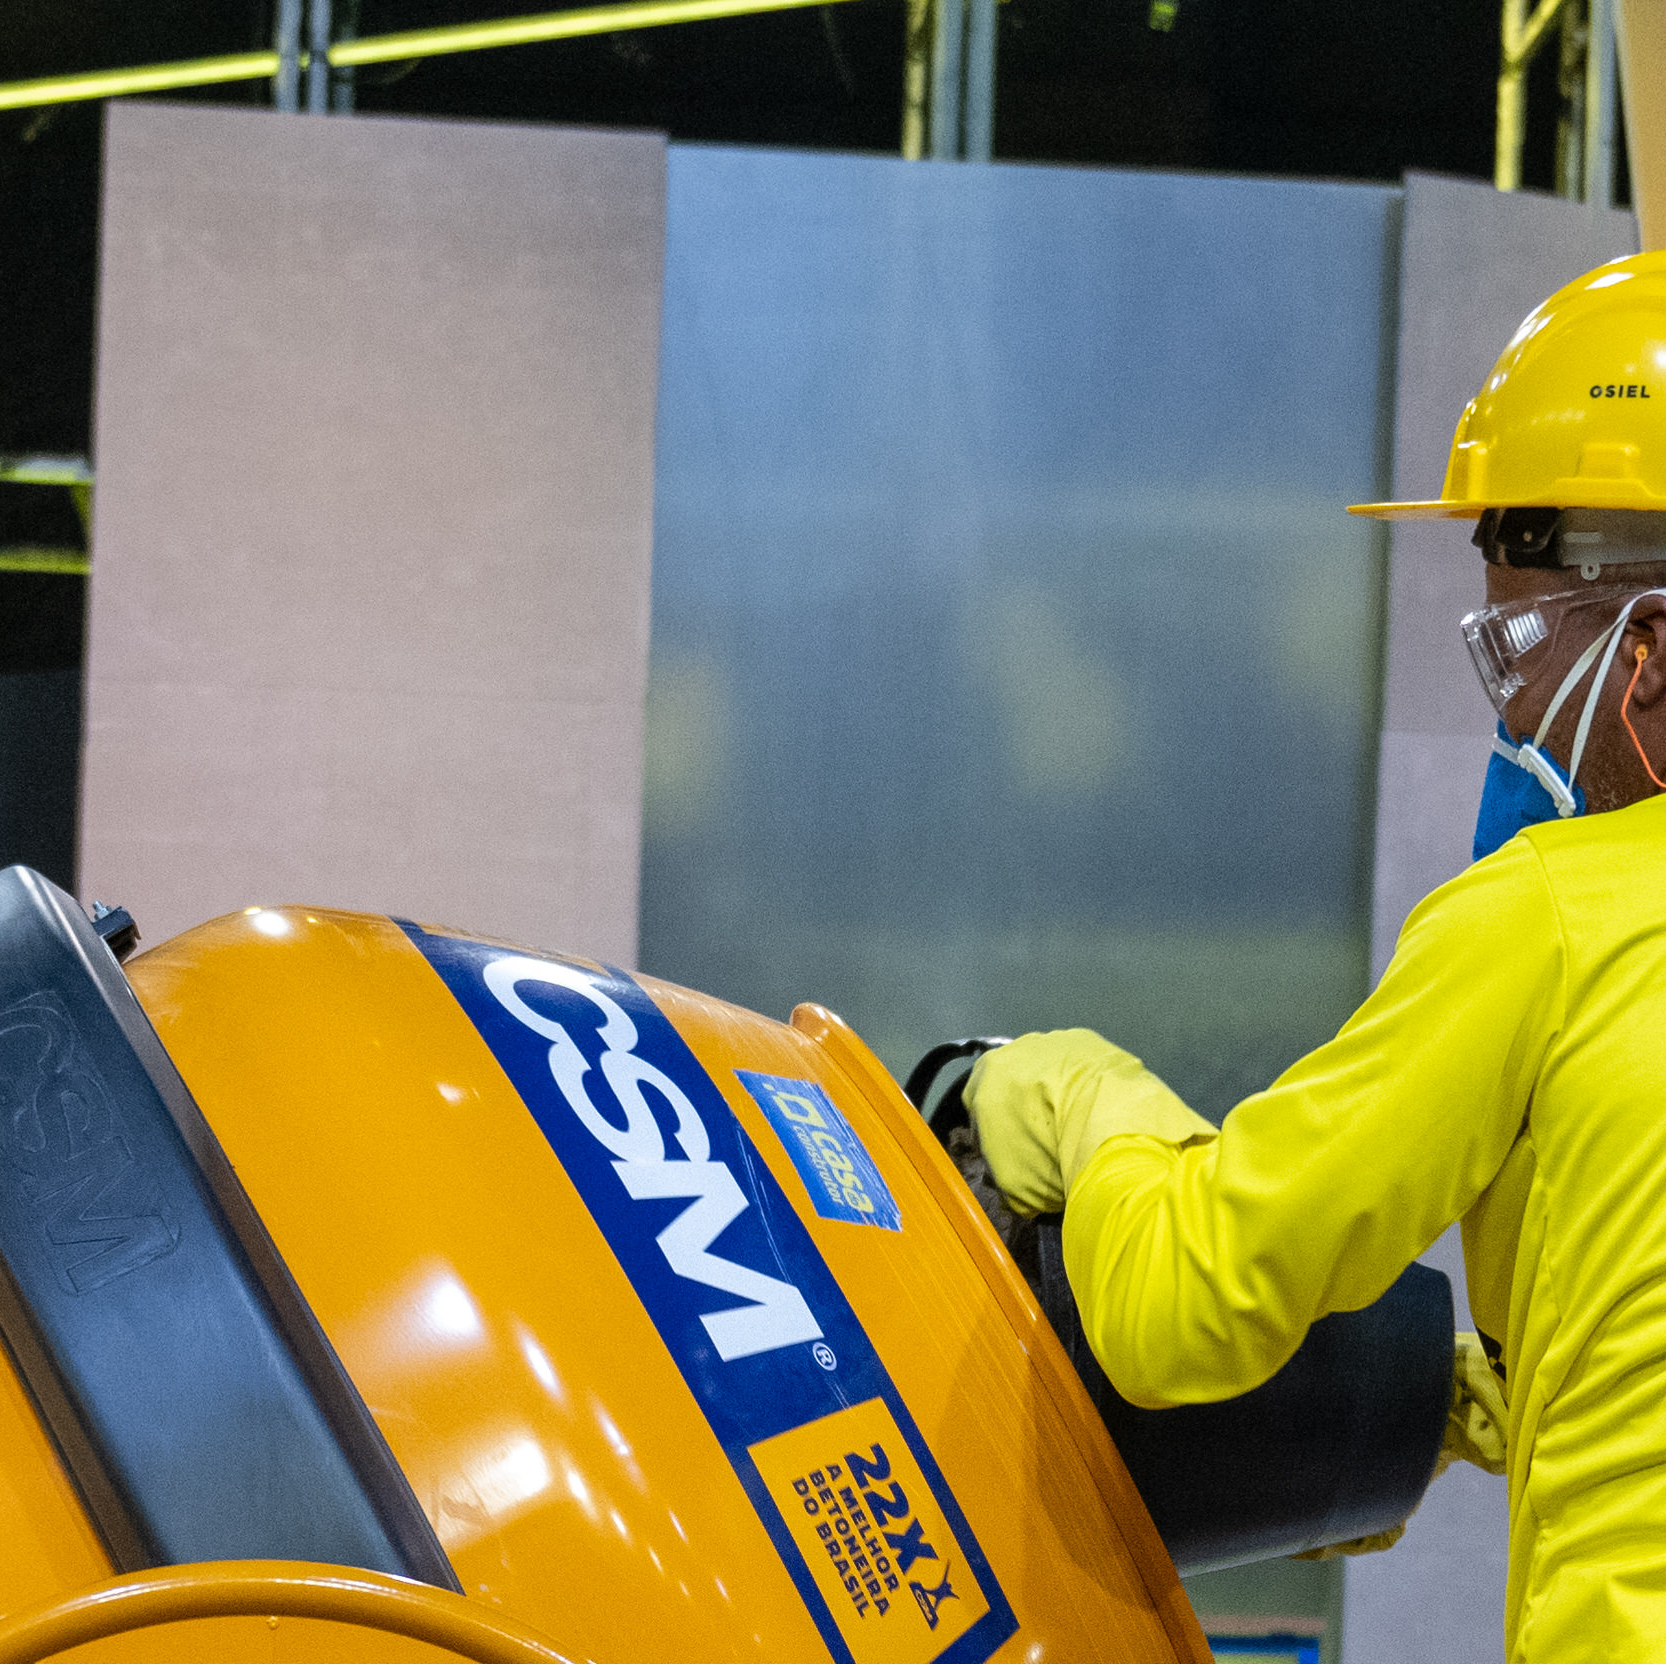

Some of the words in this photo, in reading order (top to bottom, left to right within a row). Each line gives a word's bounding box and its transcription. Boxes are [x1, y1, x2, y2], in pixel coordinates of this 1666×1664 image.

[1589, 385, 1651, 398] OSIEL
[482, 956, 825, 1362] CSM
[793, 1125, 846, 1208] construtor
[811, 1130, 875, 1213] casa
[791, 1477, 821, 1517] DO
[815, 1520, 871, 1620] BRASIL
[808, 1468, 891, 1617] BETONEIRA
[825, 1464, 843, 1482] A
[838, 1485, 900, 1593] MELHOR
[843, 1442, 940, 1576] 22X
